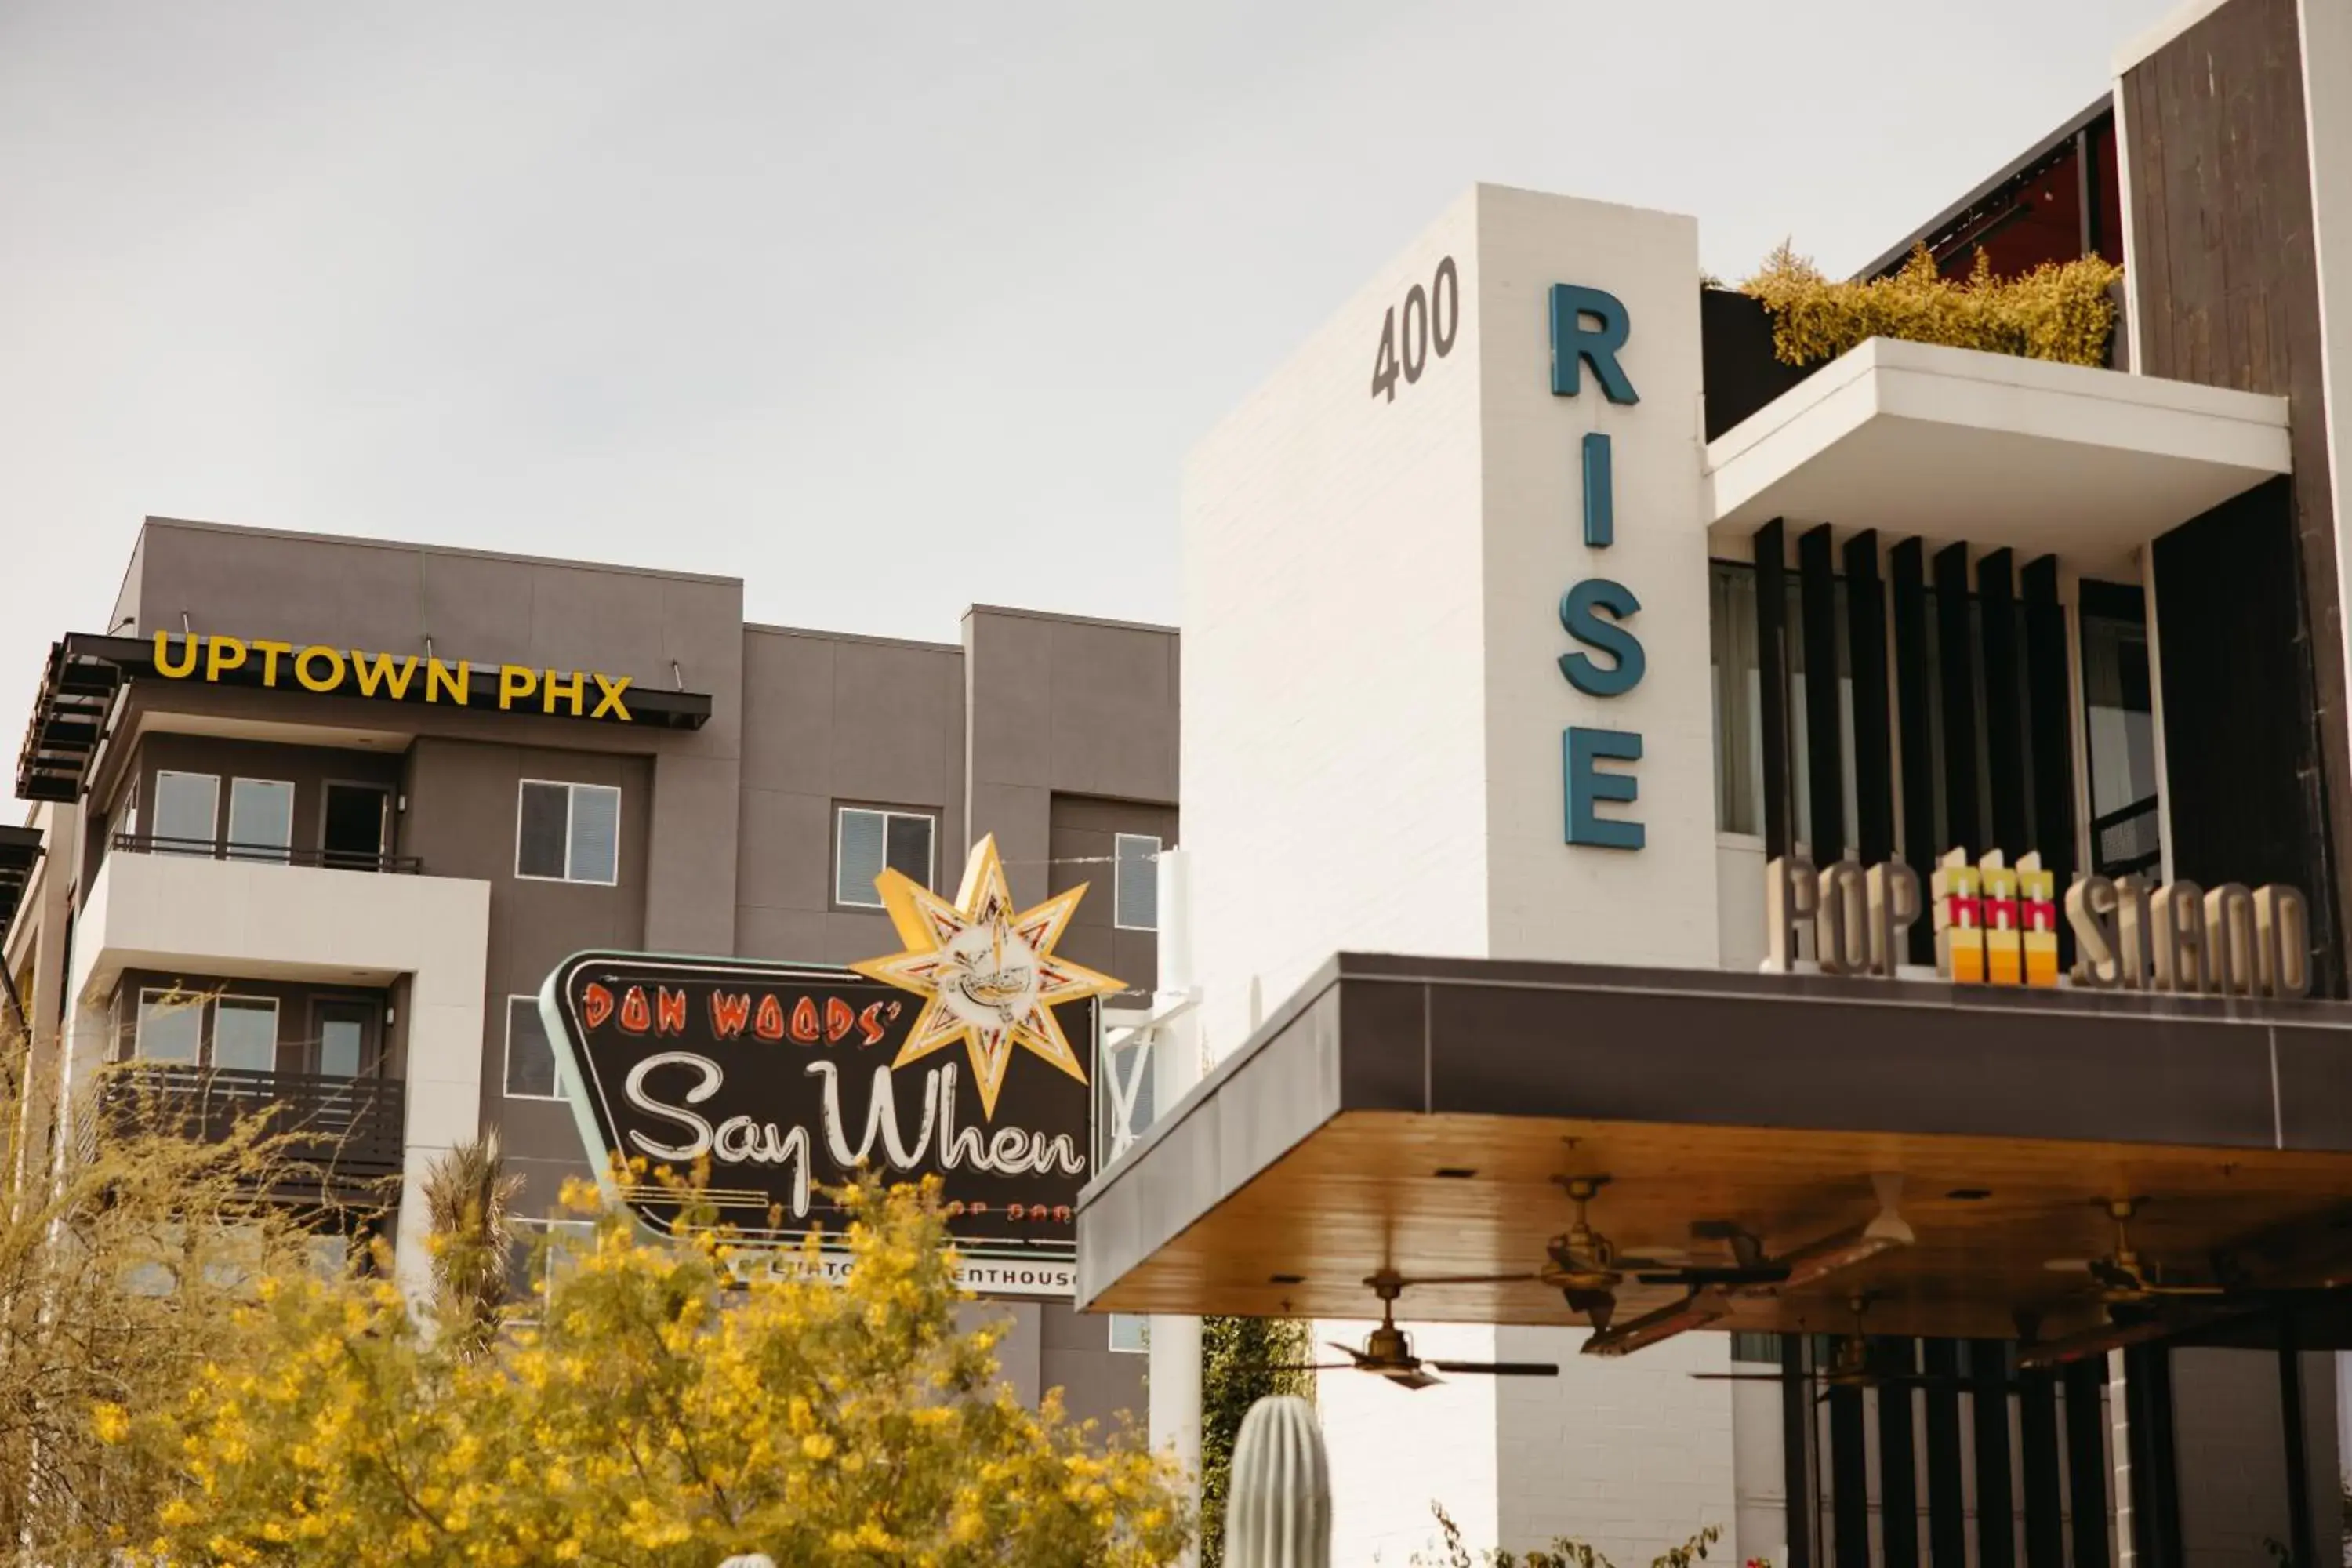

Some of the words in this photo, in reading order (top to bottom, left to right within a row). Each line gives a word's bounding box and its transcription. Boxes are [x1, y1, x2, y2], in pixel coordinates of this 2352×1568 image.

[1371, 256, 1459, 404] 400
[1549, 282, 1646, 851] RISE
[153, 629, 470, 706] UPTOWN
[499, 664, 633, 721] PHX
[1767, 856, 1922, 977] POP
[2066, 874, 2311, 998] STAND
[584, 982, 686, 1033] DON
[713, 989, 902, 1046] WOODS'
[625, 1051, 810, 1218] Say
[806, 1060, 1084, 1177] When
[951, 1267, 1077, 1286] ENTHOUS
